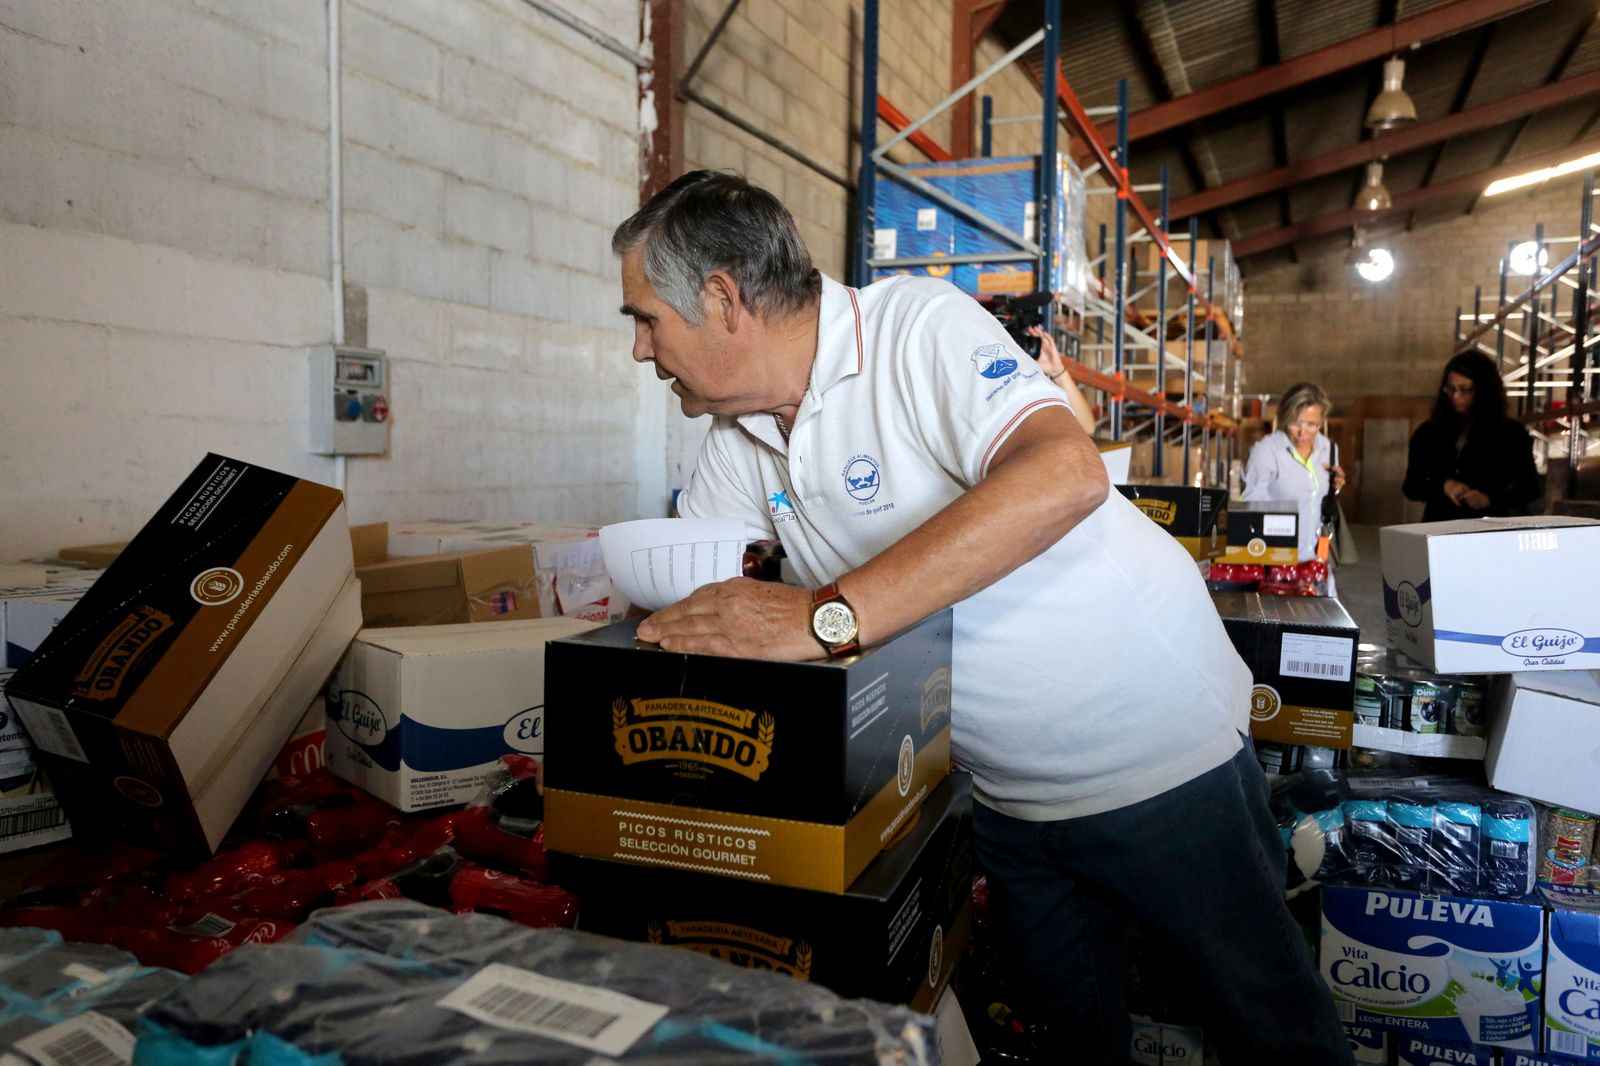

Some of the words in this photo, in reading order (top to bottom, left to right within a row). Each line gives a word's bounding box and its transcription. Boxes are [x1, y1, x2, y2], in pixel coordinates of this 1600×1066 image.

[179, 502, 201, 525] PICOS
[208, 543, 294, 653] www.panaderiaobando.com
[94, 618, 163, 691] OBANDO
[1511, 635, 1528, 649] El
[1532, 635, 1574, 651] Guijo
[1523, 659, 1539, 667] Gran
[1541, 658, 1566, 666] Calidad
[694, 704, 741, 722] ARTESANA
[517, 716, 542, 740] El
[628, 725, 757, 768] OBANDO
[619, 821, 667, 837] PICOS
[674, 828, 758, 851] RÚSTICOS
[619, 837, 690, 857] SELECCIÓN
[692, 848, 757, 867] GOURMET
[1365, 891, 1495, 928] PULEVA
[1342, 946, 1369, 960] Vita
[1330, 959, 1431, 995] Calcio
[1359, 1015, 1384, 1025] LECHE
[1385, 1016, 1429, 1031] ENTERA
[1409, 1040, 1477, 1066] PULEVA
